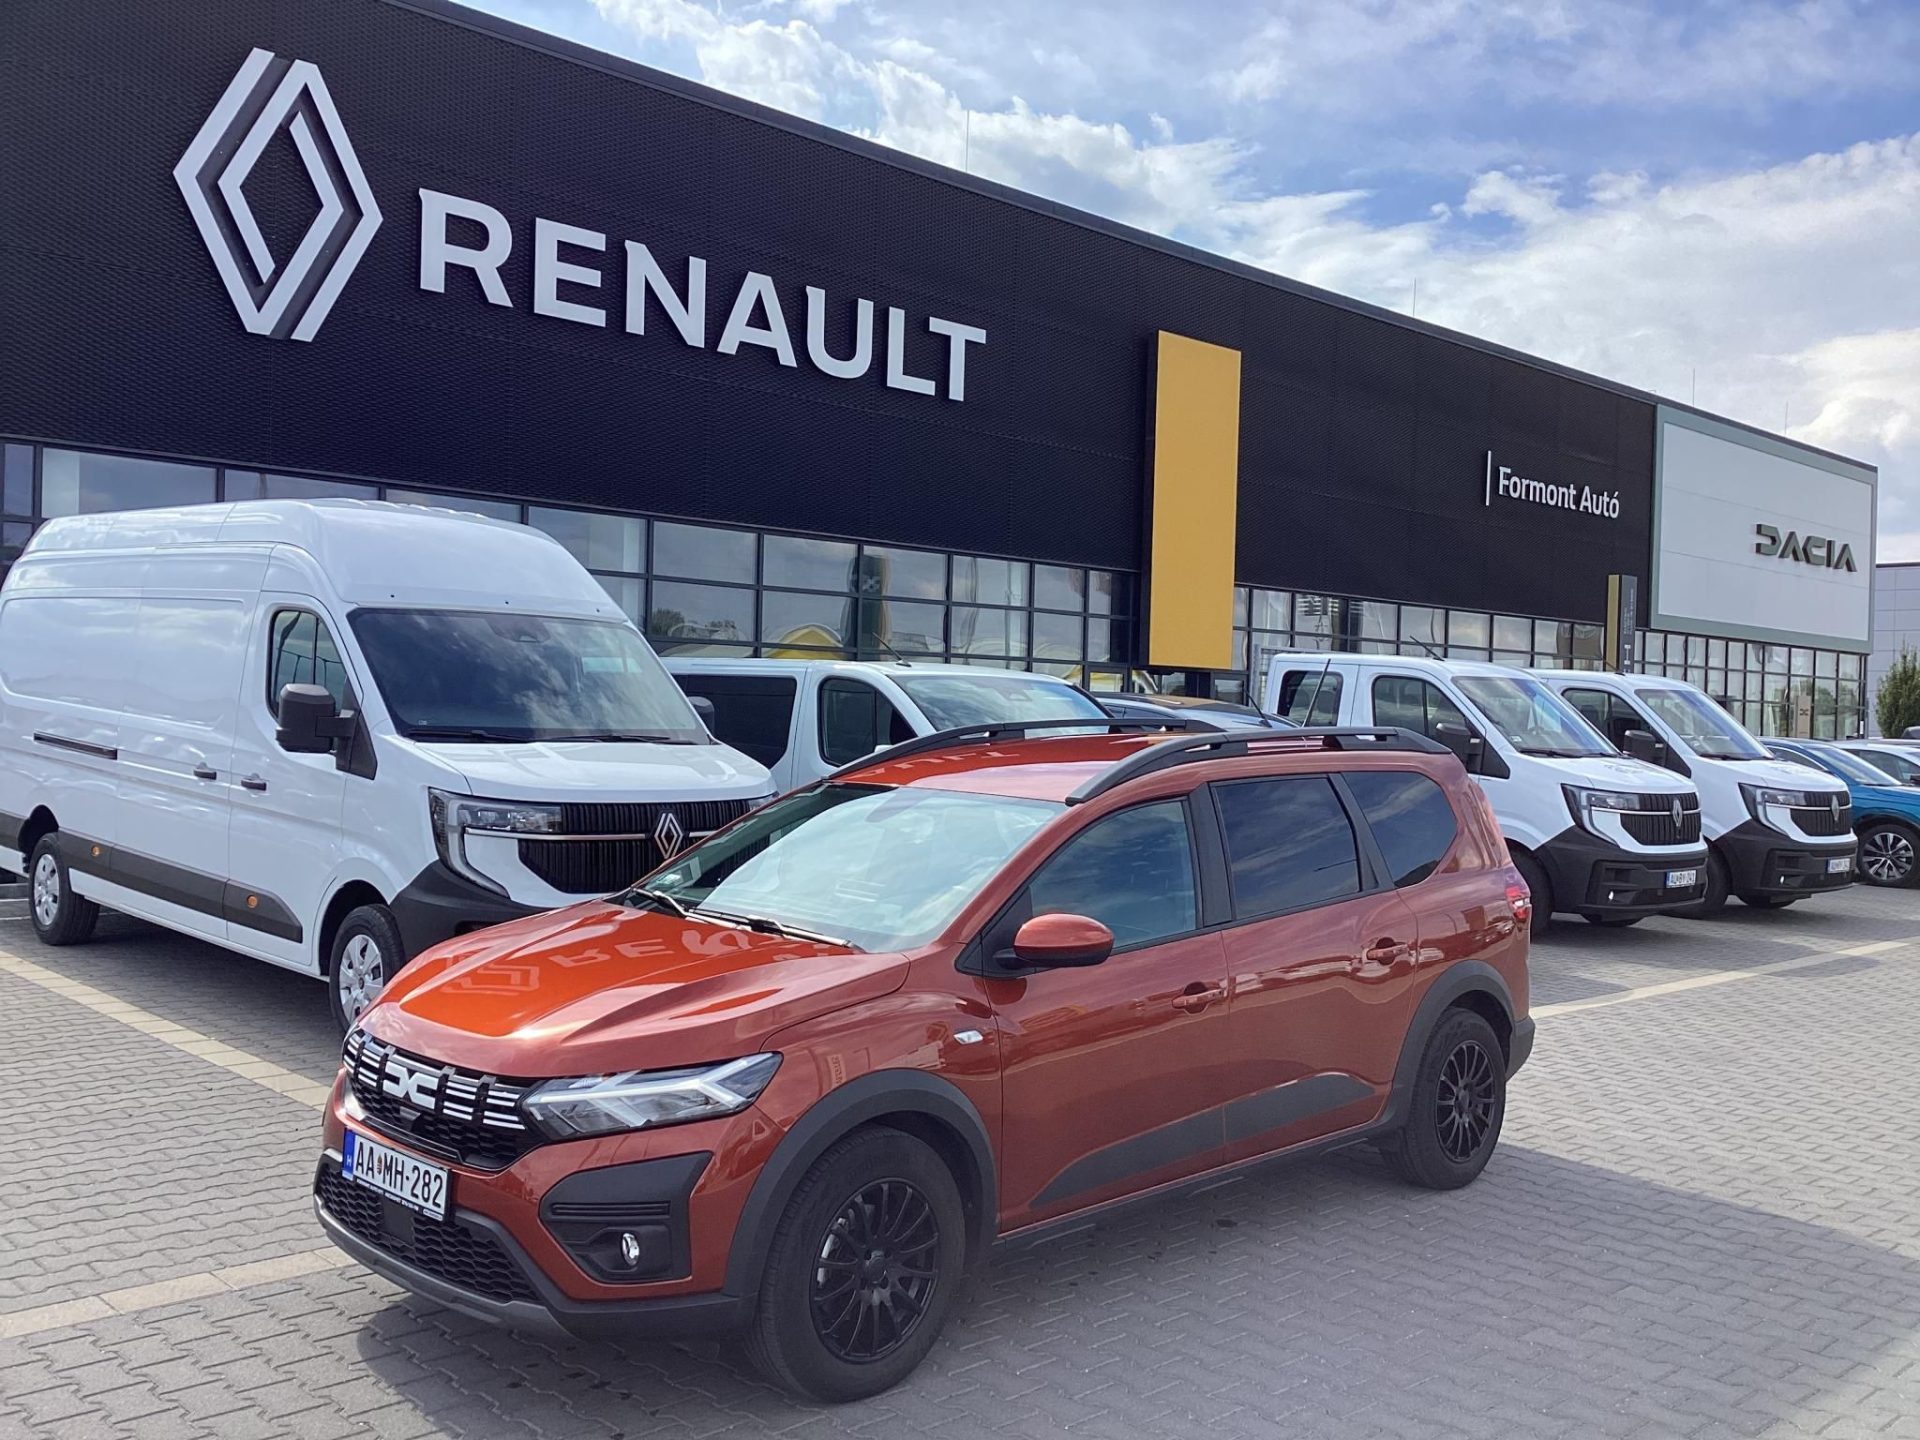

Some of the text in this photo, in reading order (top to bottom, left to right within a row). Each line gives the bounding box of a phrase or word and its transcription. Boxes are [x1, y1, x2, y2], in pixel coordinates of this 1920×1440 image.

[418, 187, 987, 402] RENAULT
[1498, 466, 1619, 519] Formont Autó
[1755, 523, 1858, 572] DACIA
